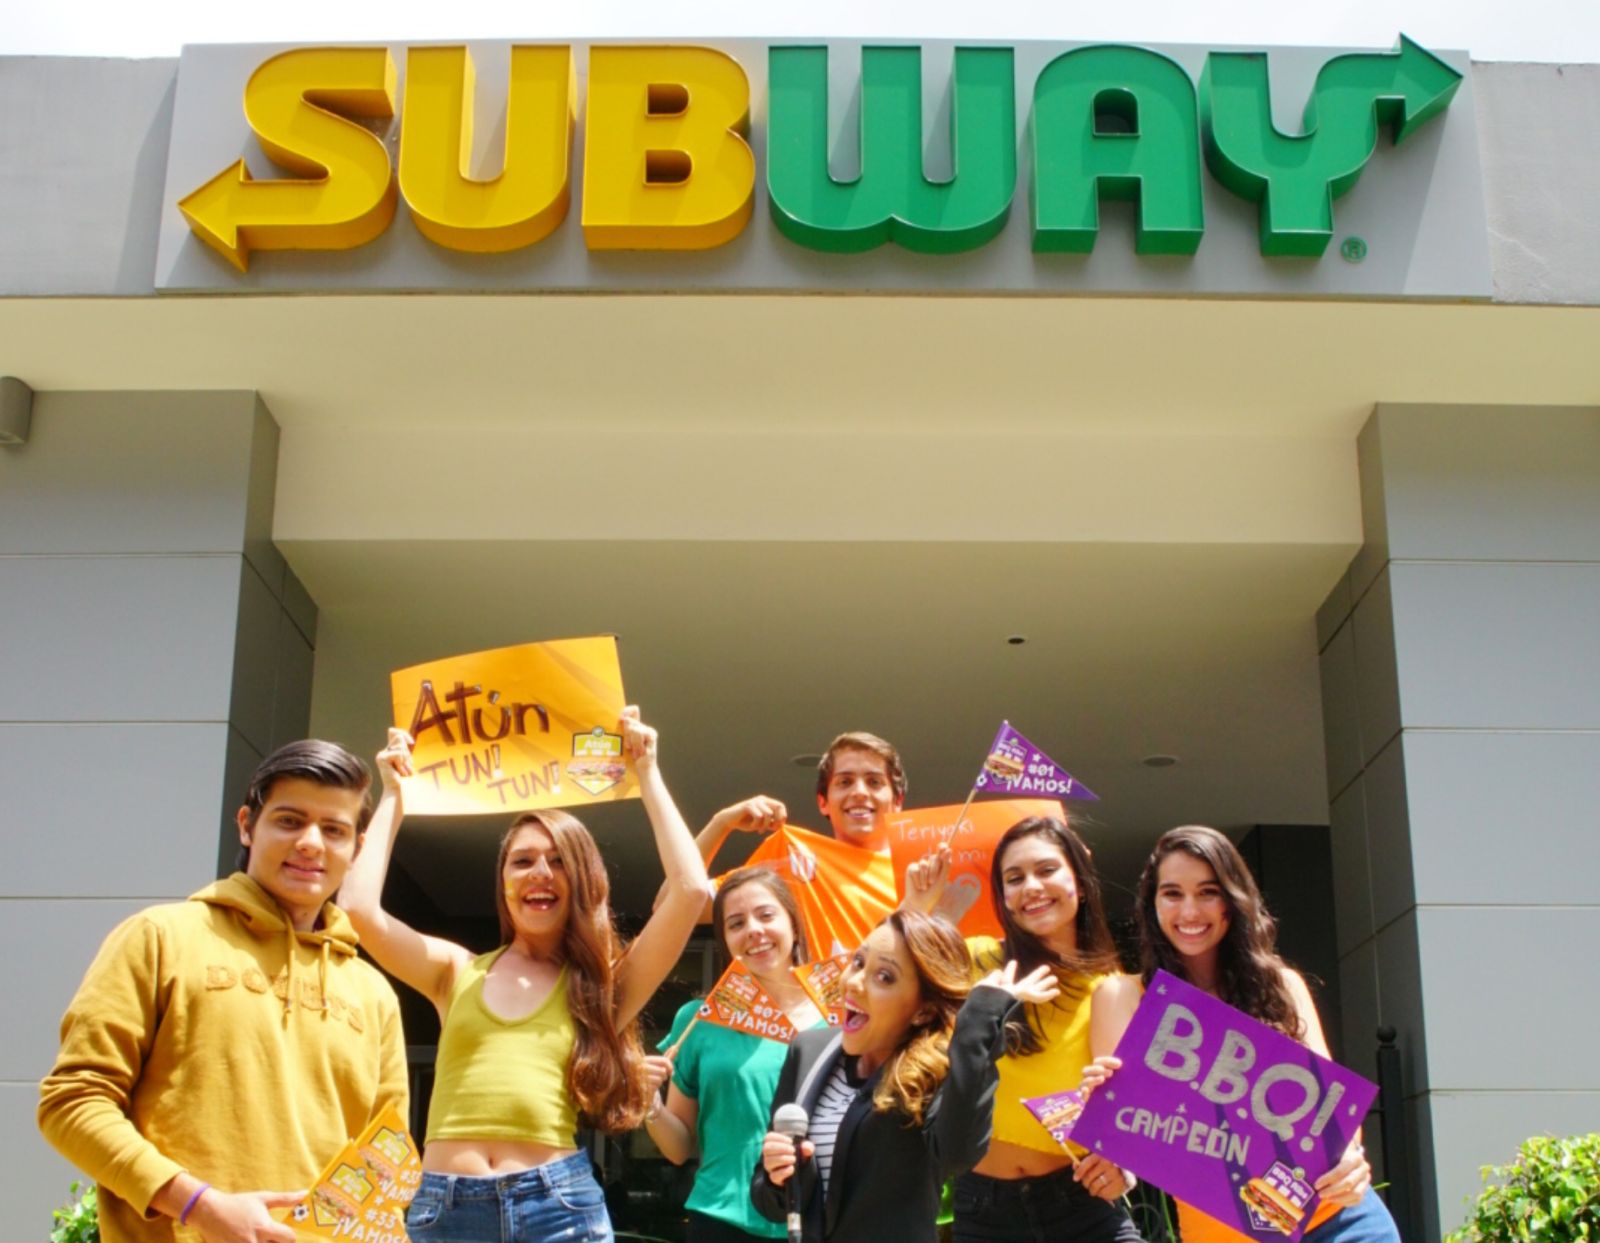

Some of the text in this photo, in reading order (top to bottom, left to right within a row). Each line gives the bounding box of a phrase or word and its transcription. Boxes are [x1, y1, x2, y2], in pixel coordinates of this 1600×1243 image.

[178, 33, 1463, 271] SUBWAY
[411, 680, 550, 749] Atún
[418, 744, 501, 791] TUN!
[486, 760, 561, 804] TUN!
[1006, 775, 1073, 794] ¡VAMOS!
[728, 1010, 795, 1041] ¡VAMOS!
